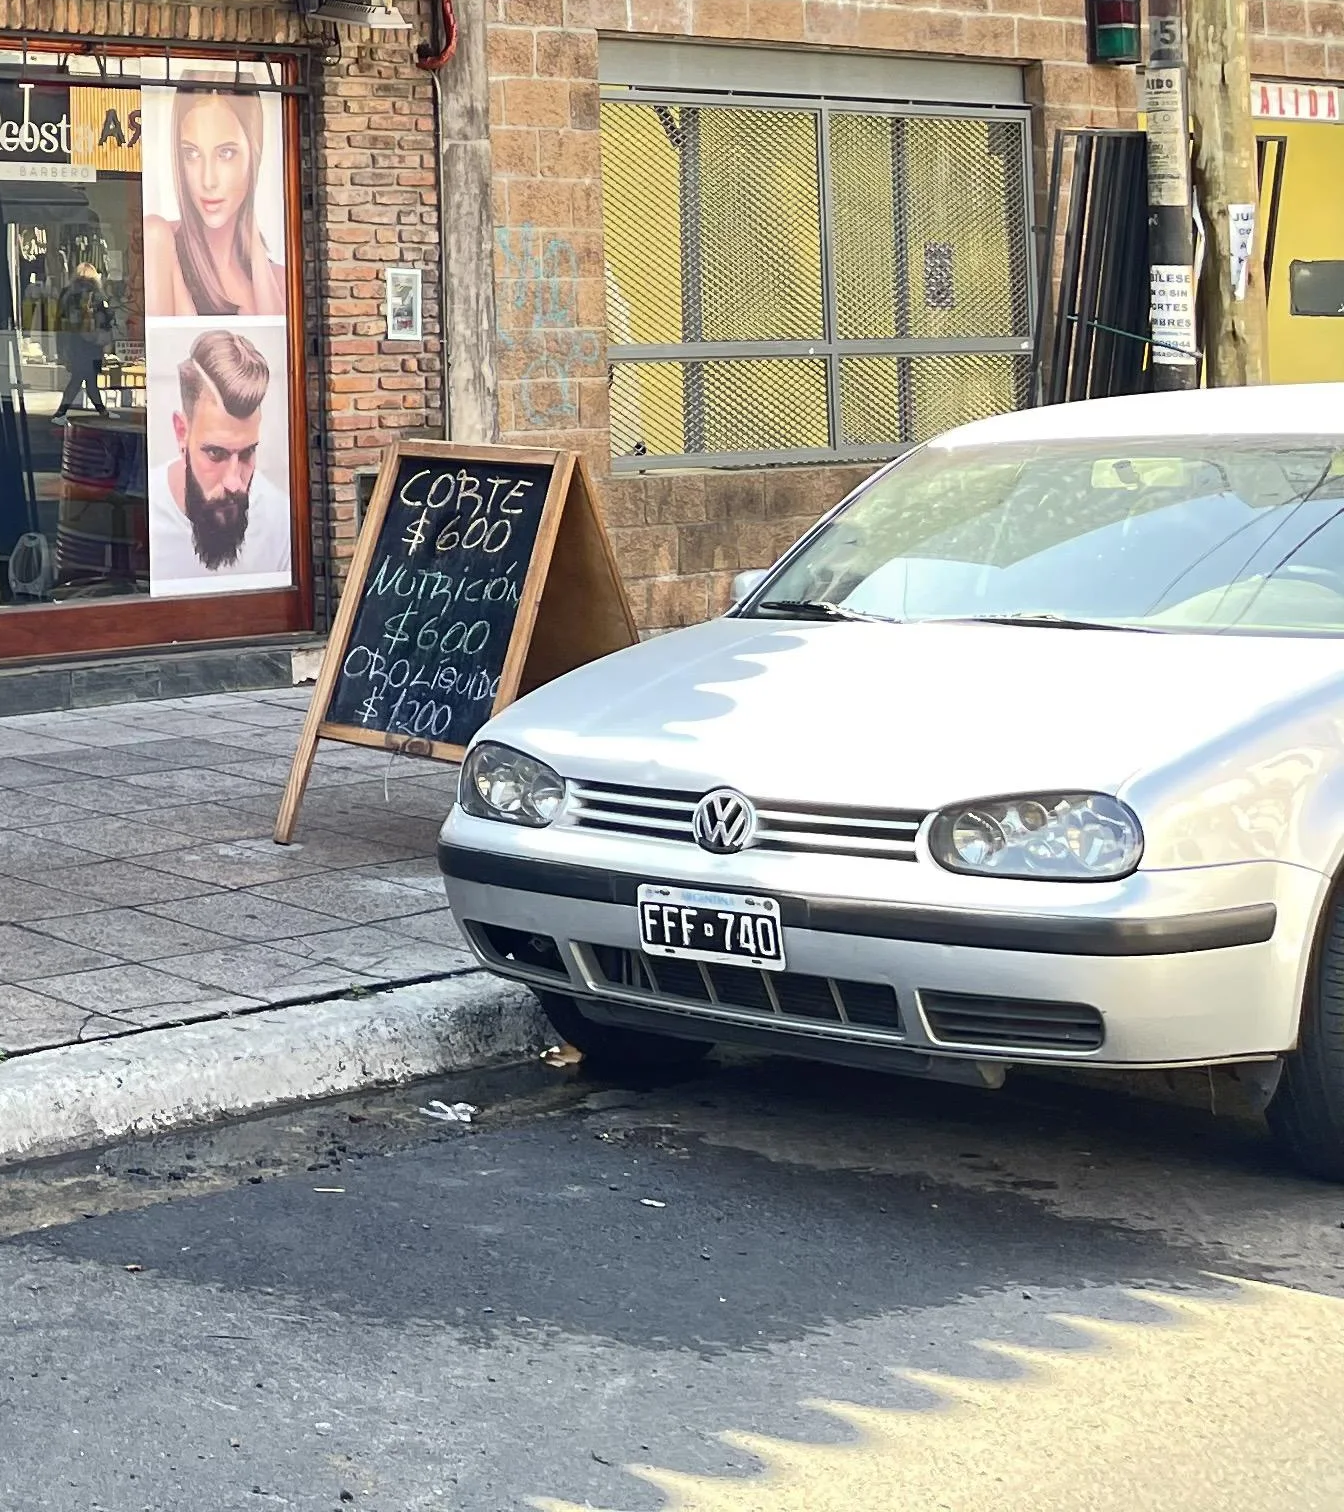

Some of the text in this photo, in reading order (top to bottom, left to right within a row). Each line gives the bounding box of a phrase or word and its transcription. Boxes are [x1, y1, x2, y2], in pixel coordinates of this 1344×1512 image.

[1259, 85, 1337, 119] ALIDA
[18, 164, 91, 180] BARBERO
[399, 468, 535, 519] CORTE
